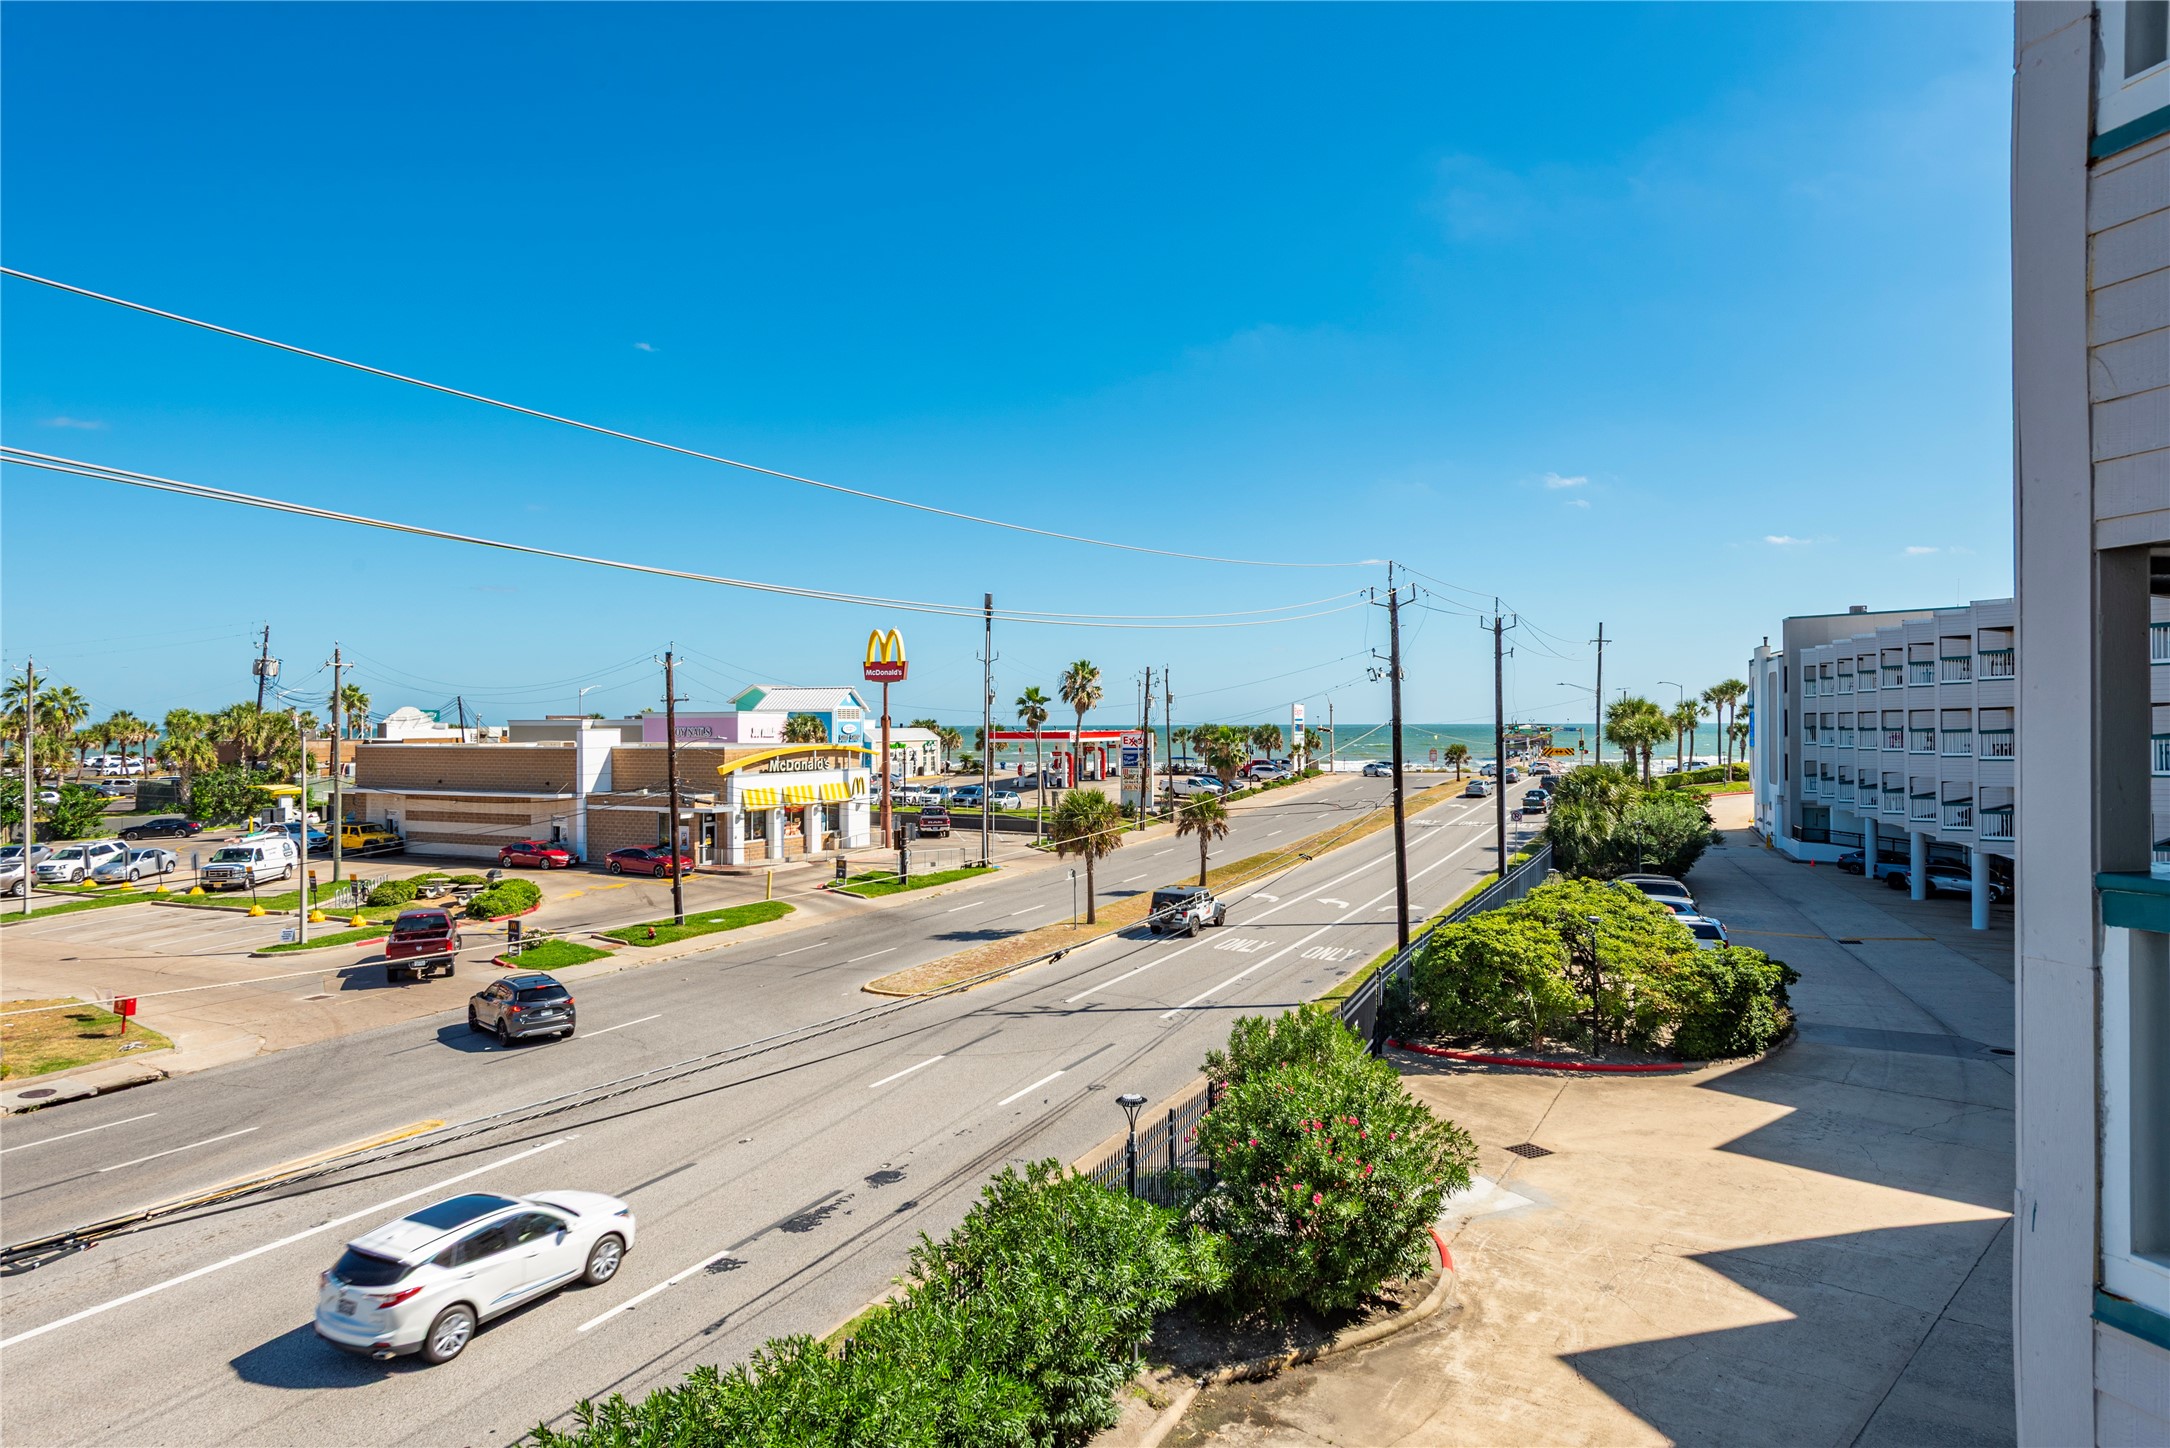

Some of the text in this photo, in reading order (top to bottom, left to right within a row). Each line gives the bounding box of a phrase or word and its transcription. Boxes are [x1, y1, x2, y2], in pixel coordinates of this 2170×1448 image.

[675, 727, 687, 737] OY
[769, 758, 830, 772] McDonald's
[1213, 938, 1276, 953] ONLY
[1300, 946, 1361, 962] ONLY
